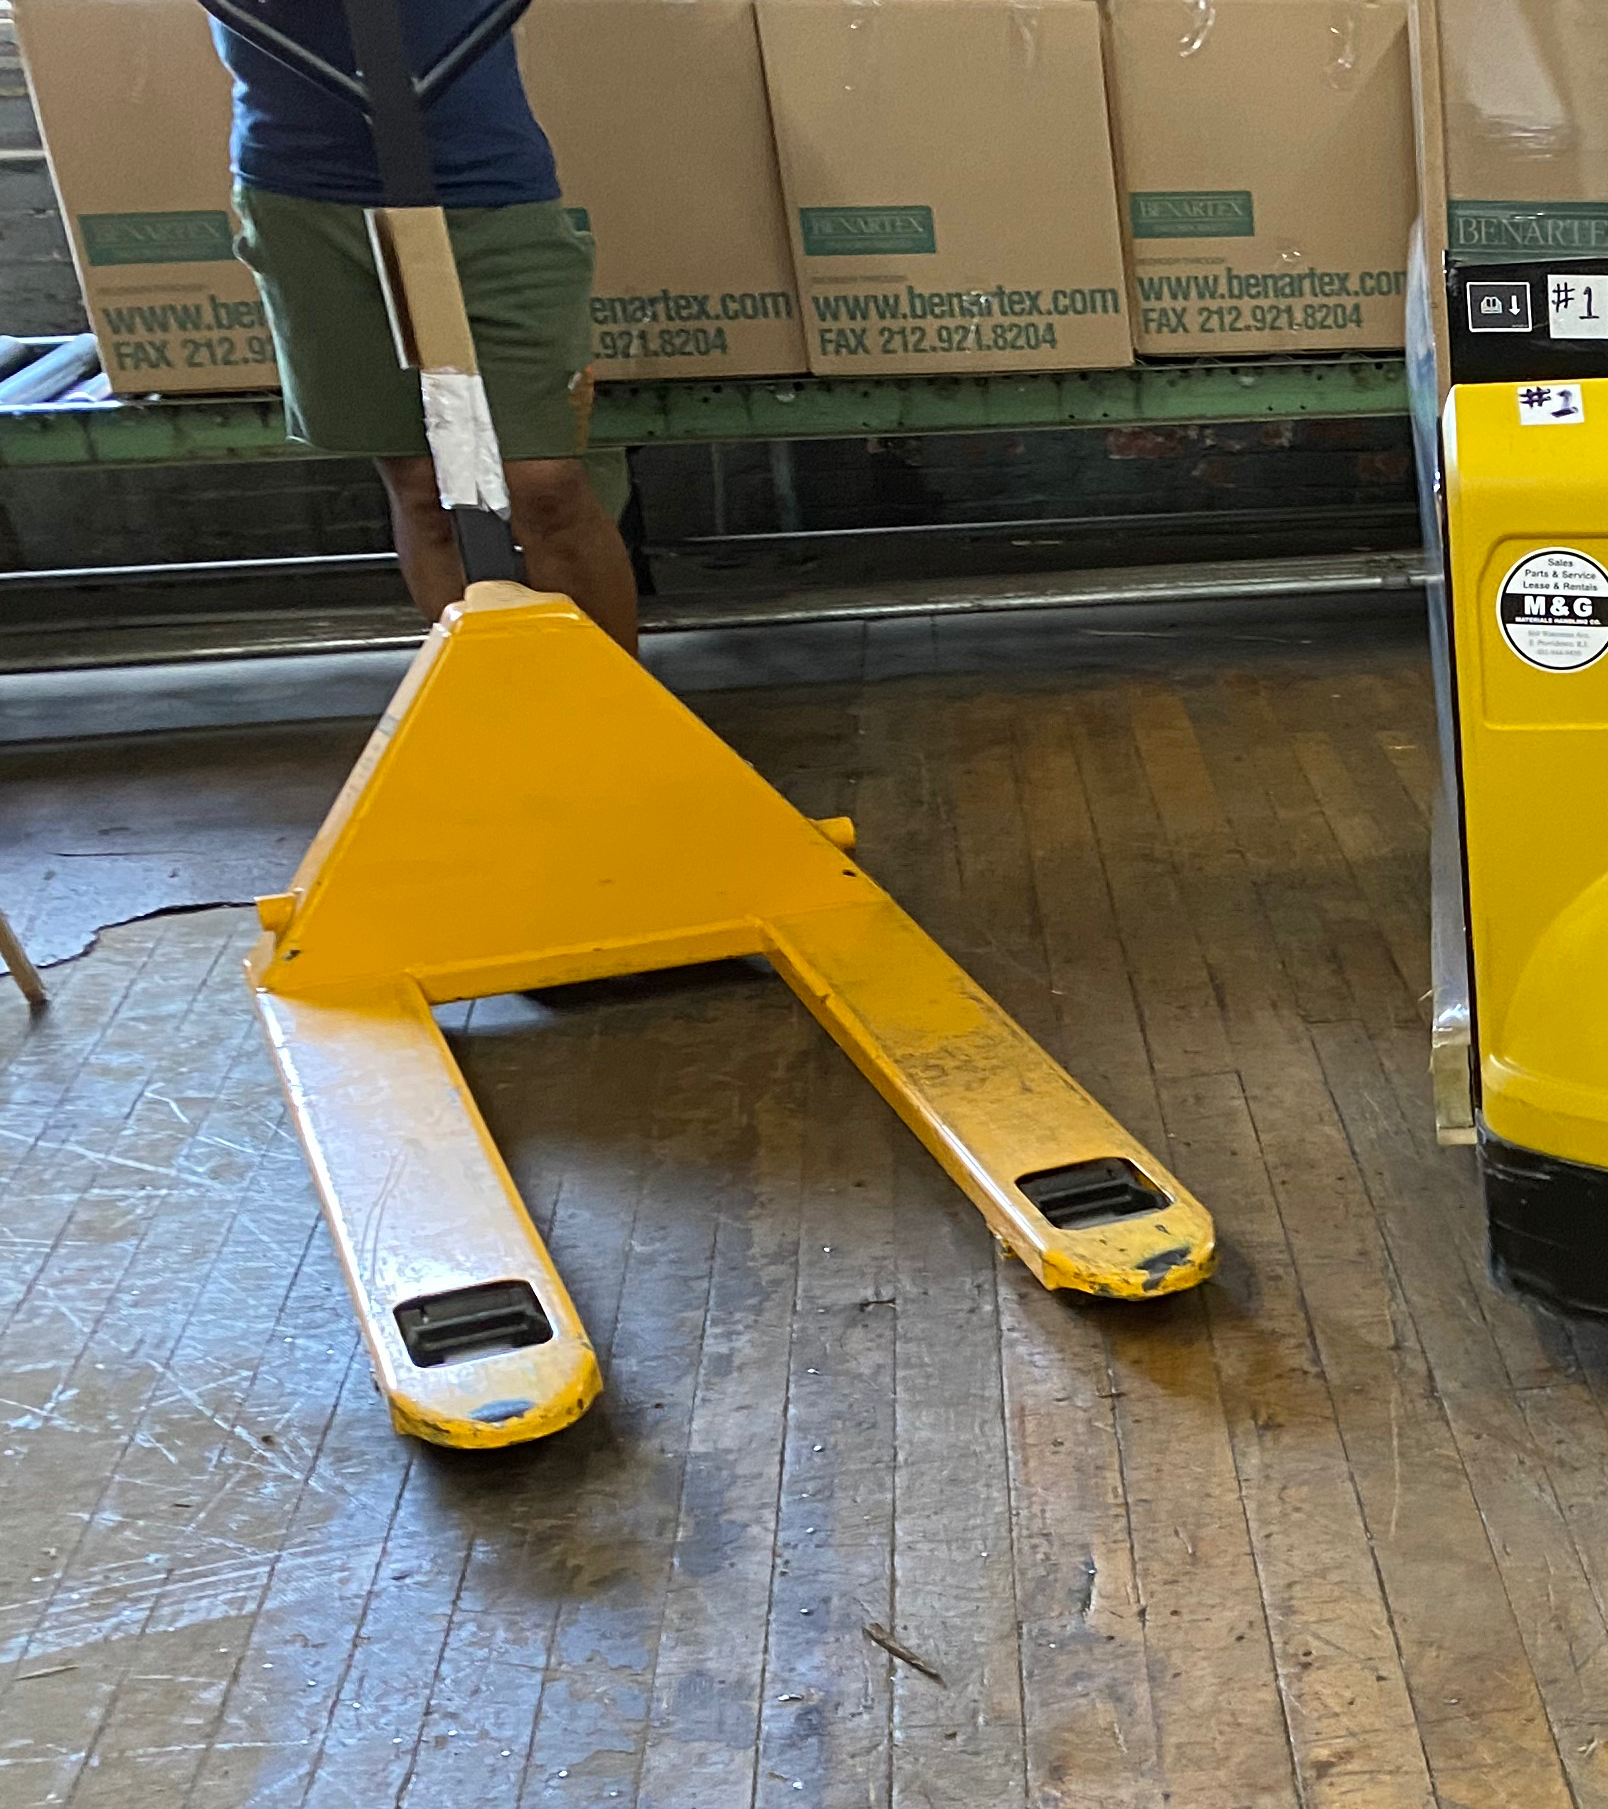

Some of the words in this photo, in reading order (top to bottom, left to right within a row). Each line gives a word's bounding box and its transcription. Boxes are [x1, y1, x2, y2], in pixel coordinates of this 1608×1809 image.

[811, 284, 1120, 322] www.benartex.com
[1551, 281, 1600, 321] #1
[1142, 307, 1190, 334] FAX
[1199, 303, 1363, 334] 212.921.8204
[818, 326, 871, 357] FAX
[878, 322, 1058, 356] 212.921.8204
[113, 340, 173, 371] FAX
[1525, 569, 1549, 579] Parts
[1552, 570, 1559, 579] &
[1562, 571, 1597, 580] Service
[1547, 558, 1574, 568] Sales
[1523, 581, 1550, 590] Lease
[1553, 582, 1560, 590] &
[1563, 582, 1598, 592] Rentals
